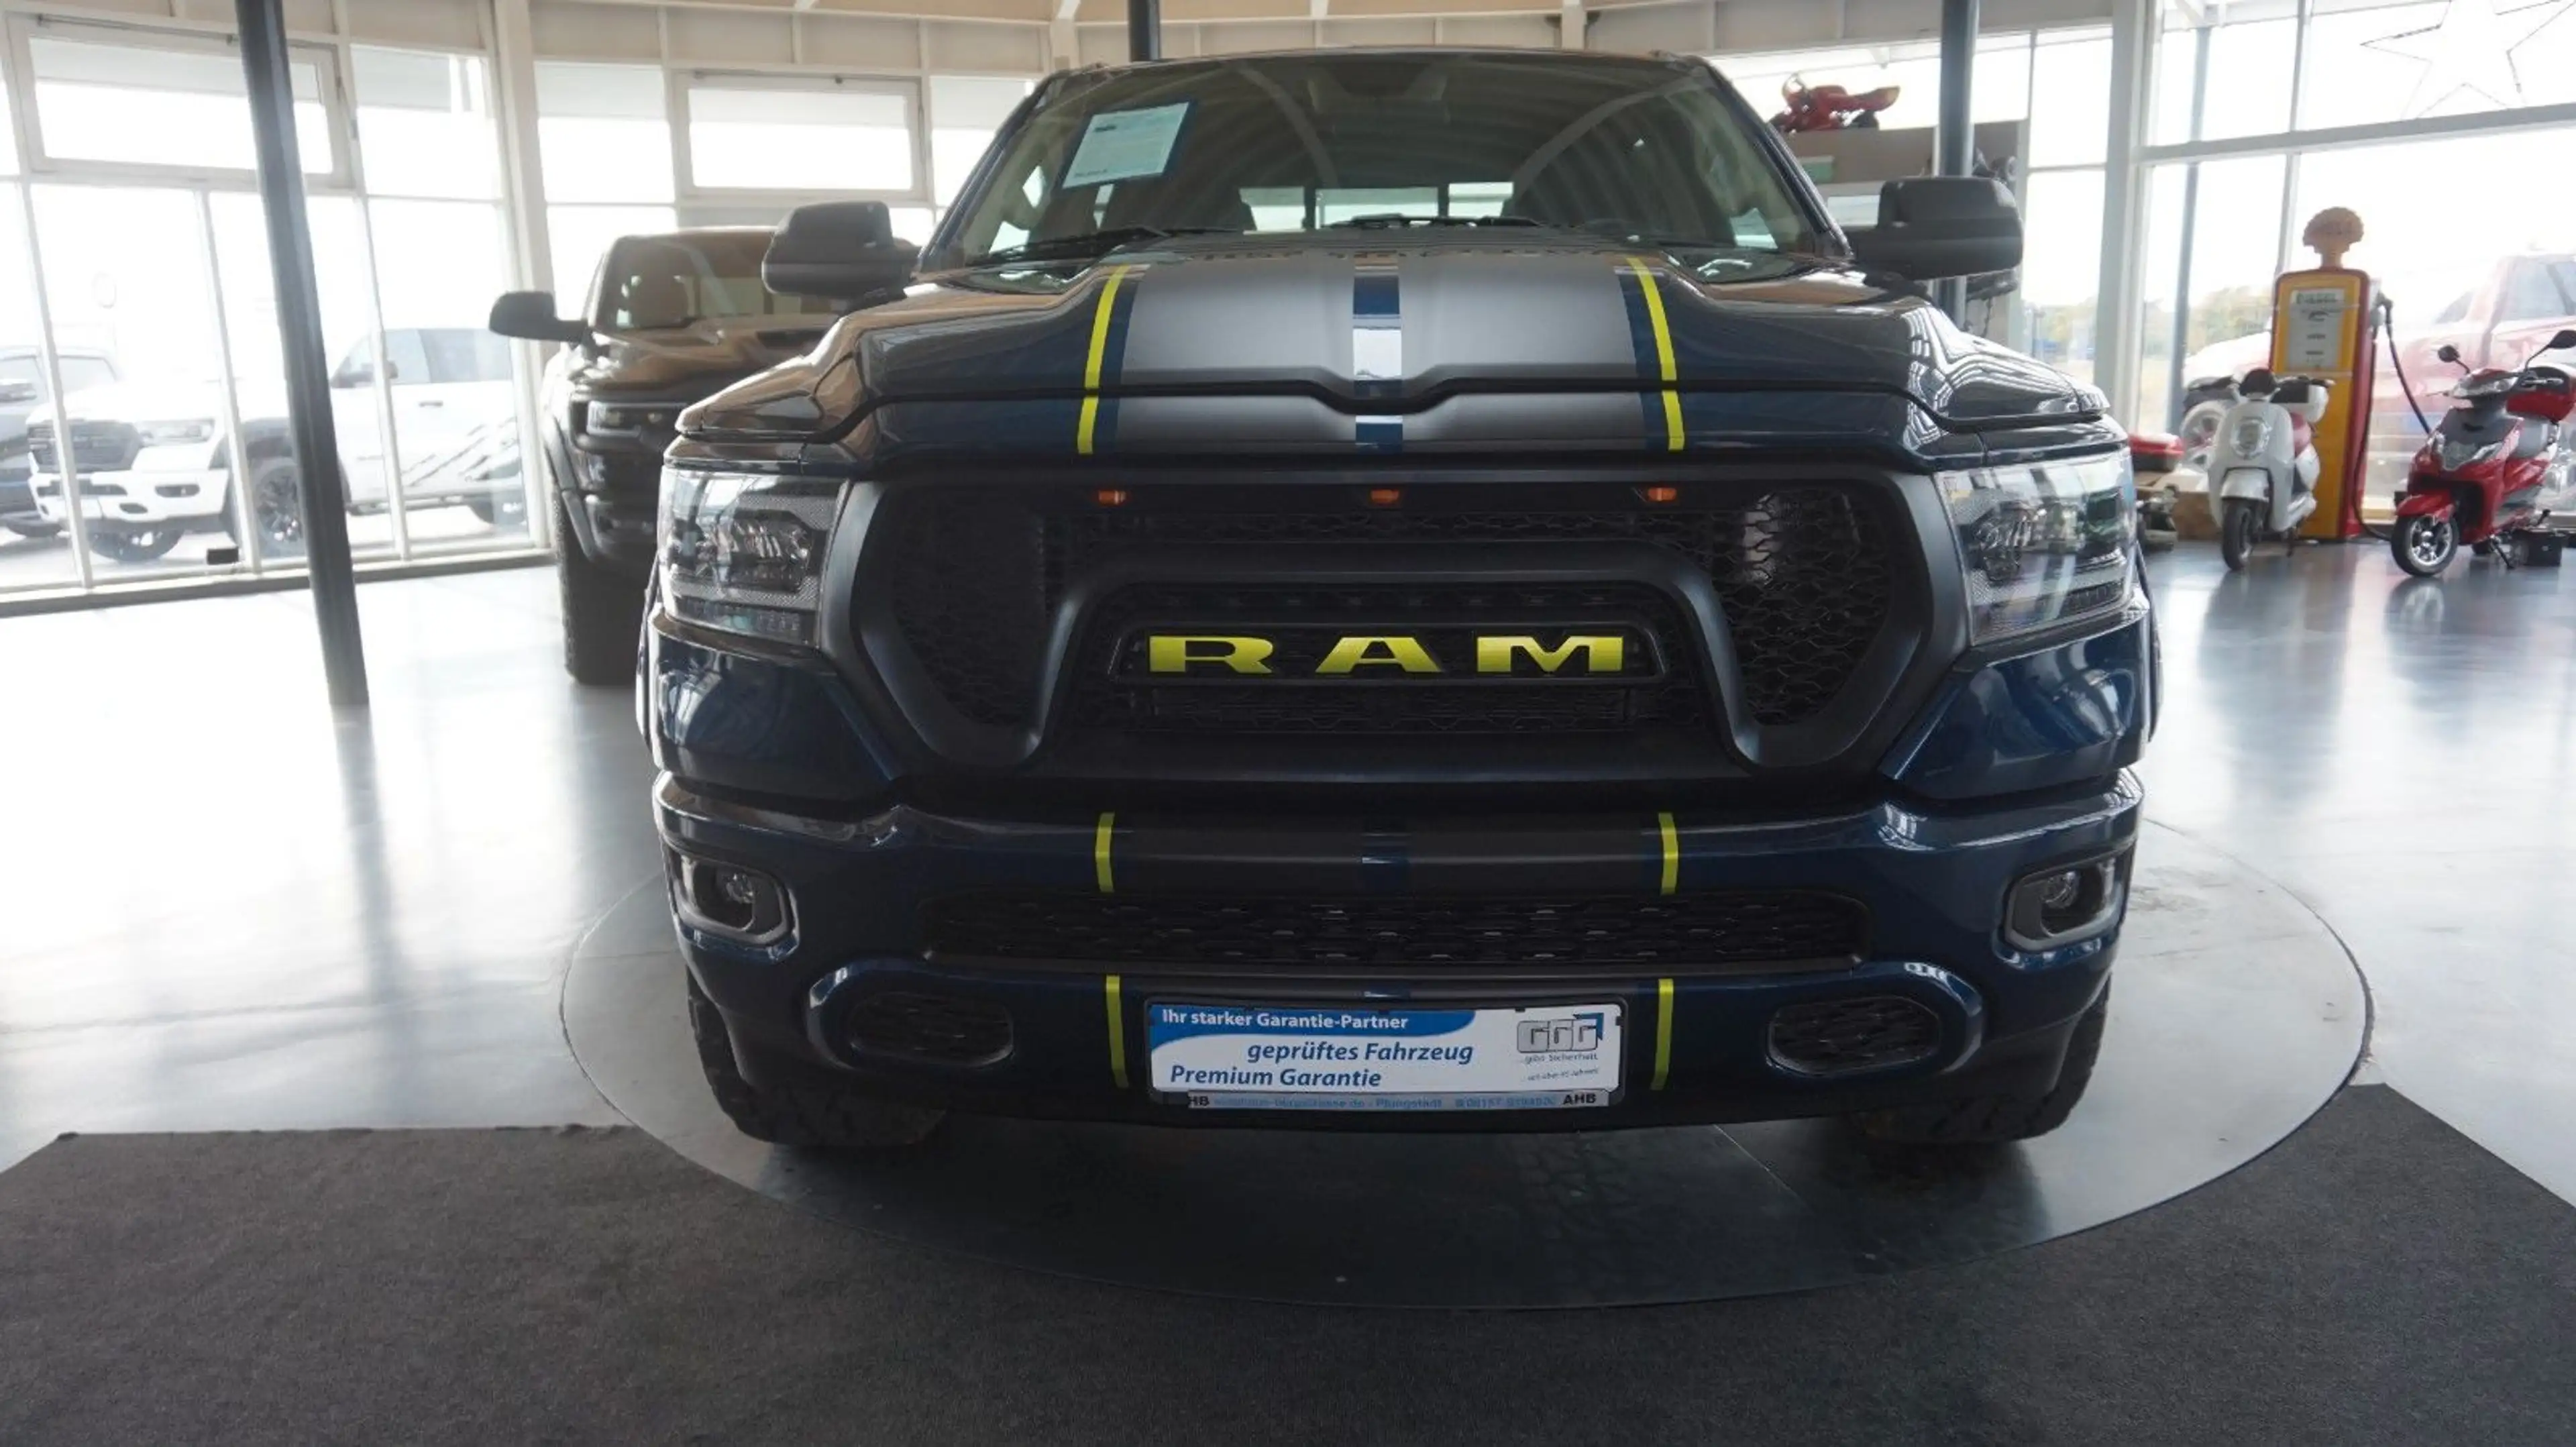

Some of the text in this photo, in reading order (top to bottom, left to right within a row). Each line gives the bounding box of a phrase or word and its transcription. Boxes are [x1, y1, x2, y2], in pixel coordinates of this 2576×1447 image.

[1148, 635, 1625, 674] RAM
[1163, 1009, 1408, 1028] Ihr starker Garantie-Partner
[1247, 1040, 1473, 1065] geprüftes Fahrzeug
[1170, 1064, 1381, 1087] Premium Garantie
[1563, 1093, 1597, 1105] AHB
